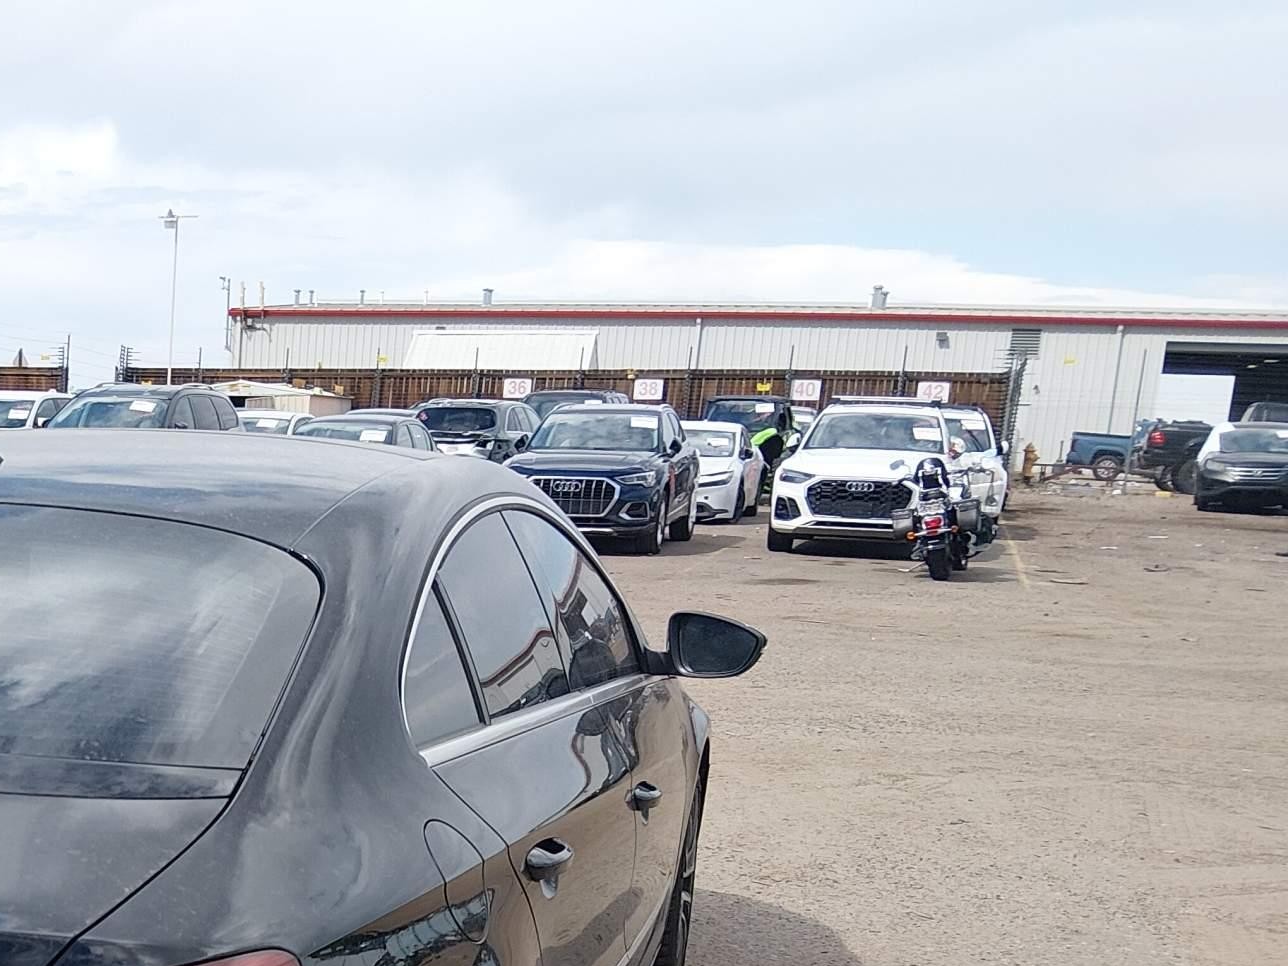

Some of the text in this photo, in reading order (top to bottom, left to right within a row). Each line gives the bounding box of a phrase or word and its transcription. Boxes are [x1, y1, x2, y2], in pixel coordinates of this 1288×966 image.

[508, 380, 528, 395] 36
[638, 381, 659, 396] 38
[795, 382, 816, 397] 40
[922, 383, 945, 400] 42
